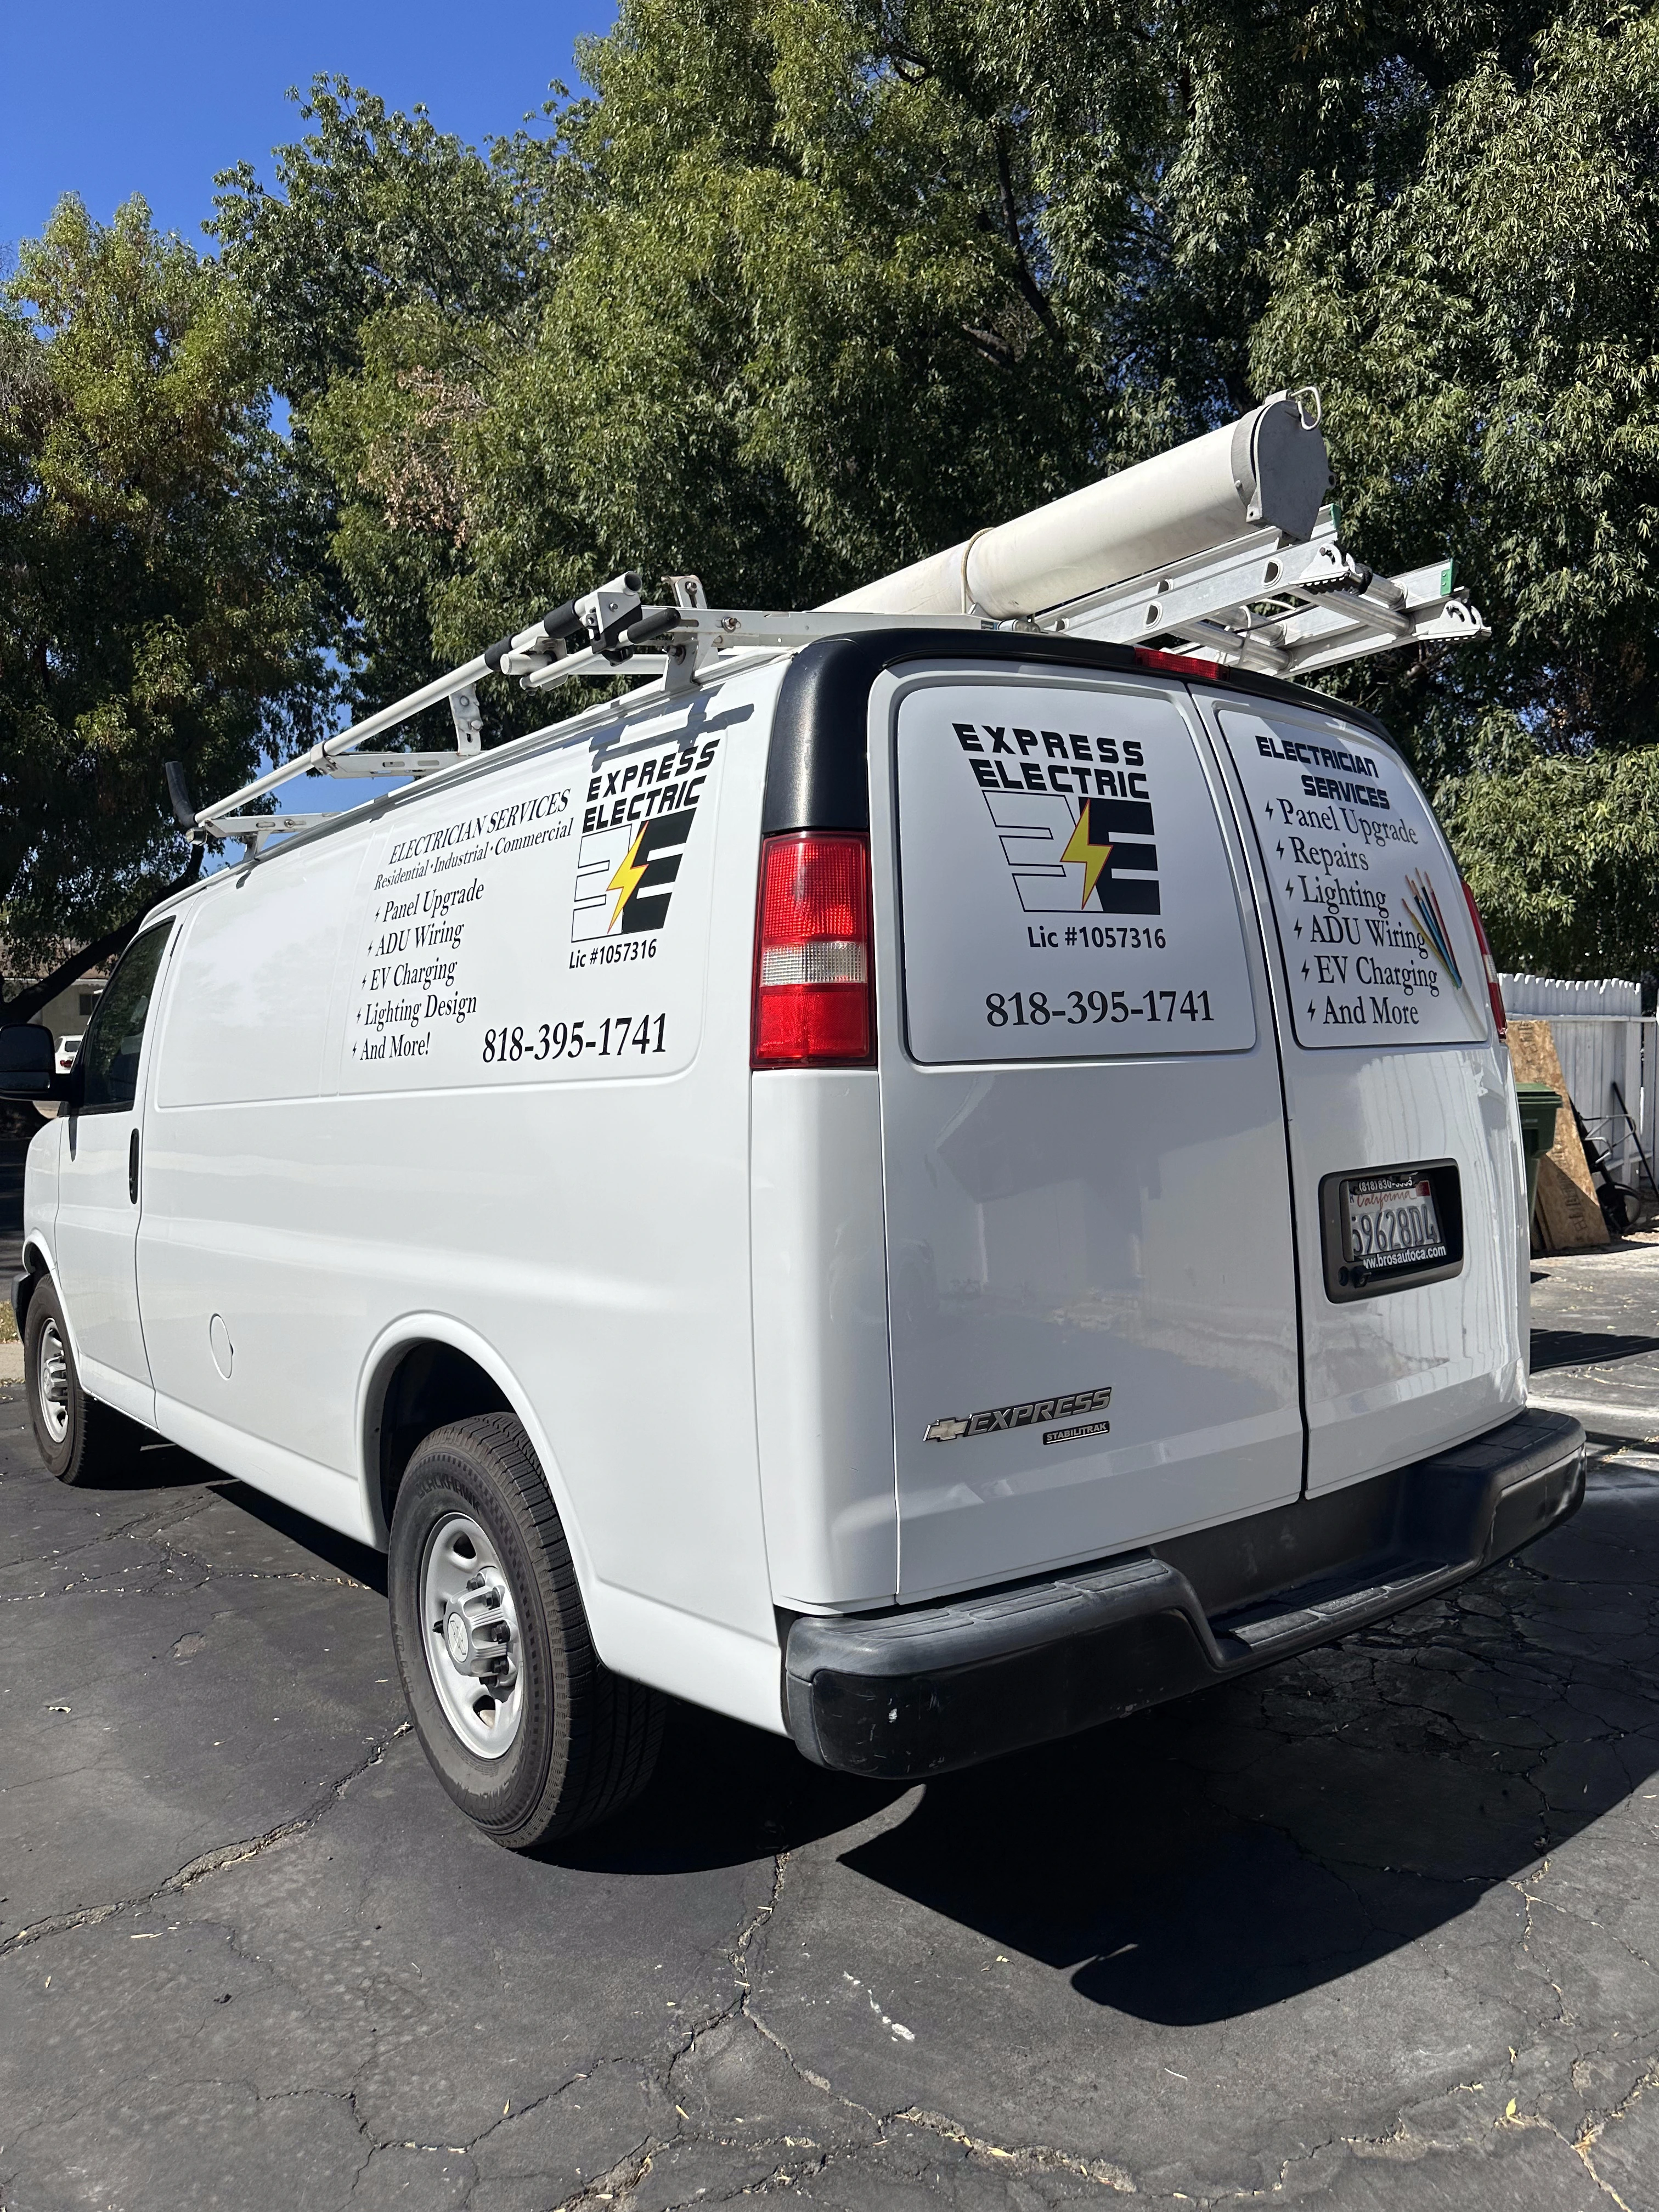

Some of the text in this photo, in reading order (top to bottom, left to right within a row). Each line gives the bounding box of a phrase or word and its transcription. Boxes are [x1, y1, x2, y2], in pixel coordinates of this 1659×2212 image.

[952, 723, 1144, 766] EXPRESS
[1255, 736, 1379, 778] ELECTRICIAN
[586, 738, 720, 803] EXPRESS
[968, 759, 1149, 799] ELECTRIC
[582, 775, 707, 834] ELECTRIC
[1301, 775, 1390, 810] SERVICES
[388, 788, 571, 865] ELECTRICIAN SERVICES
[1276, 798, 1418, 847] Panel Upgrade
[374, 817, 574, 890] Residential Industrial Commercial
[1288, 837, 1368, 876] Repairs
[382, 878, 484, 922] Panel Upgrade
[1297, 875, 1389, 918] Lighting
[375, 921, 464, 956] ADU Wiring
[569, 939, 657, 969] Lic #1057316
[1028, 926, 1166, 949] Lic #1057316
[1310, 915, 1429, 959] ADU Wiring
[369, 957, 458, 991] EV Charging
[1314, 955, 1439, 997] EV Charging
[364, 991, 476, 1032] Lighting Design
[986, 990, 1214, 1026] 818-395-1741
[1323, 996, 1419, 1024] And More
[360, 1031, 430, 1060] And More!
[483, 1013, 665, 1063] 818-395-1741
[1357, 1190, 1417, 1211] California
[968, 1389, 1110, 1436] EXPRESS
[1046, 1423, 1107, 1441] STABILITRAK
